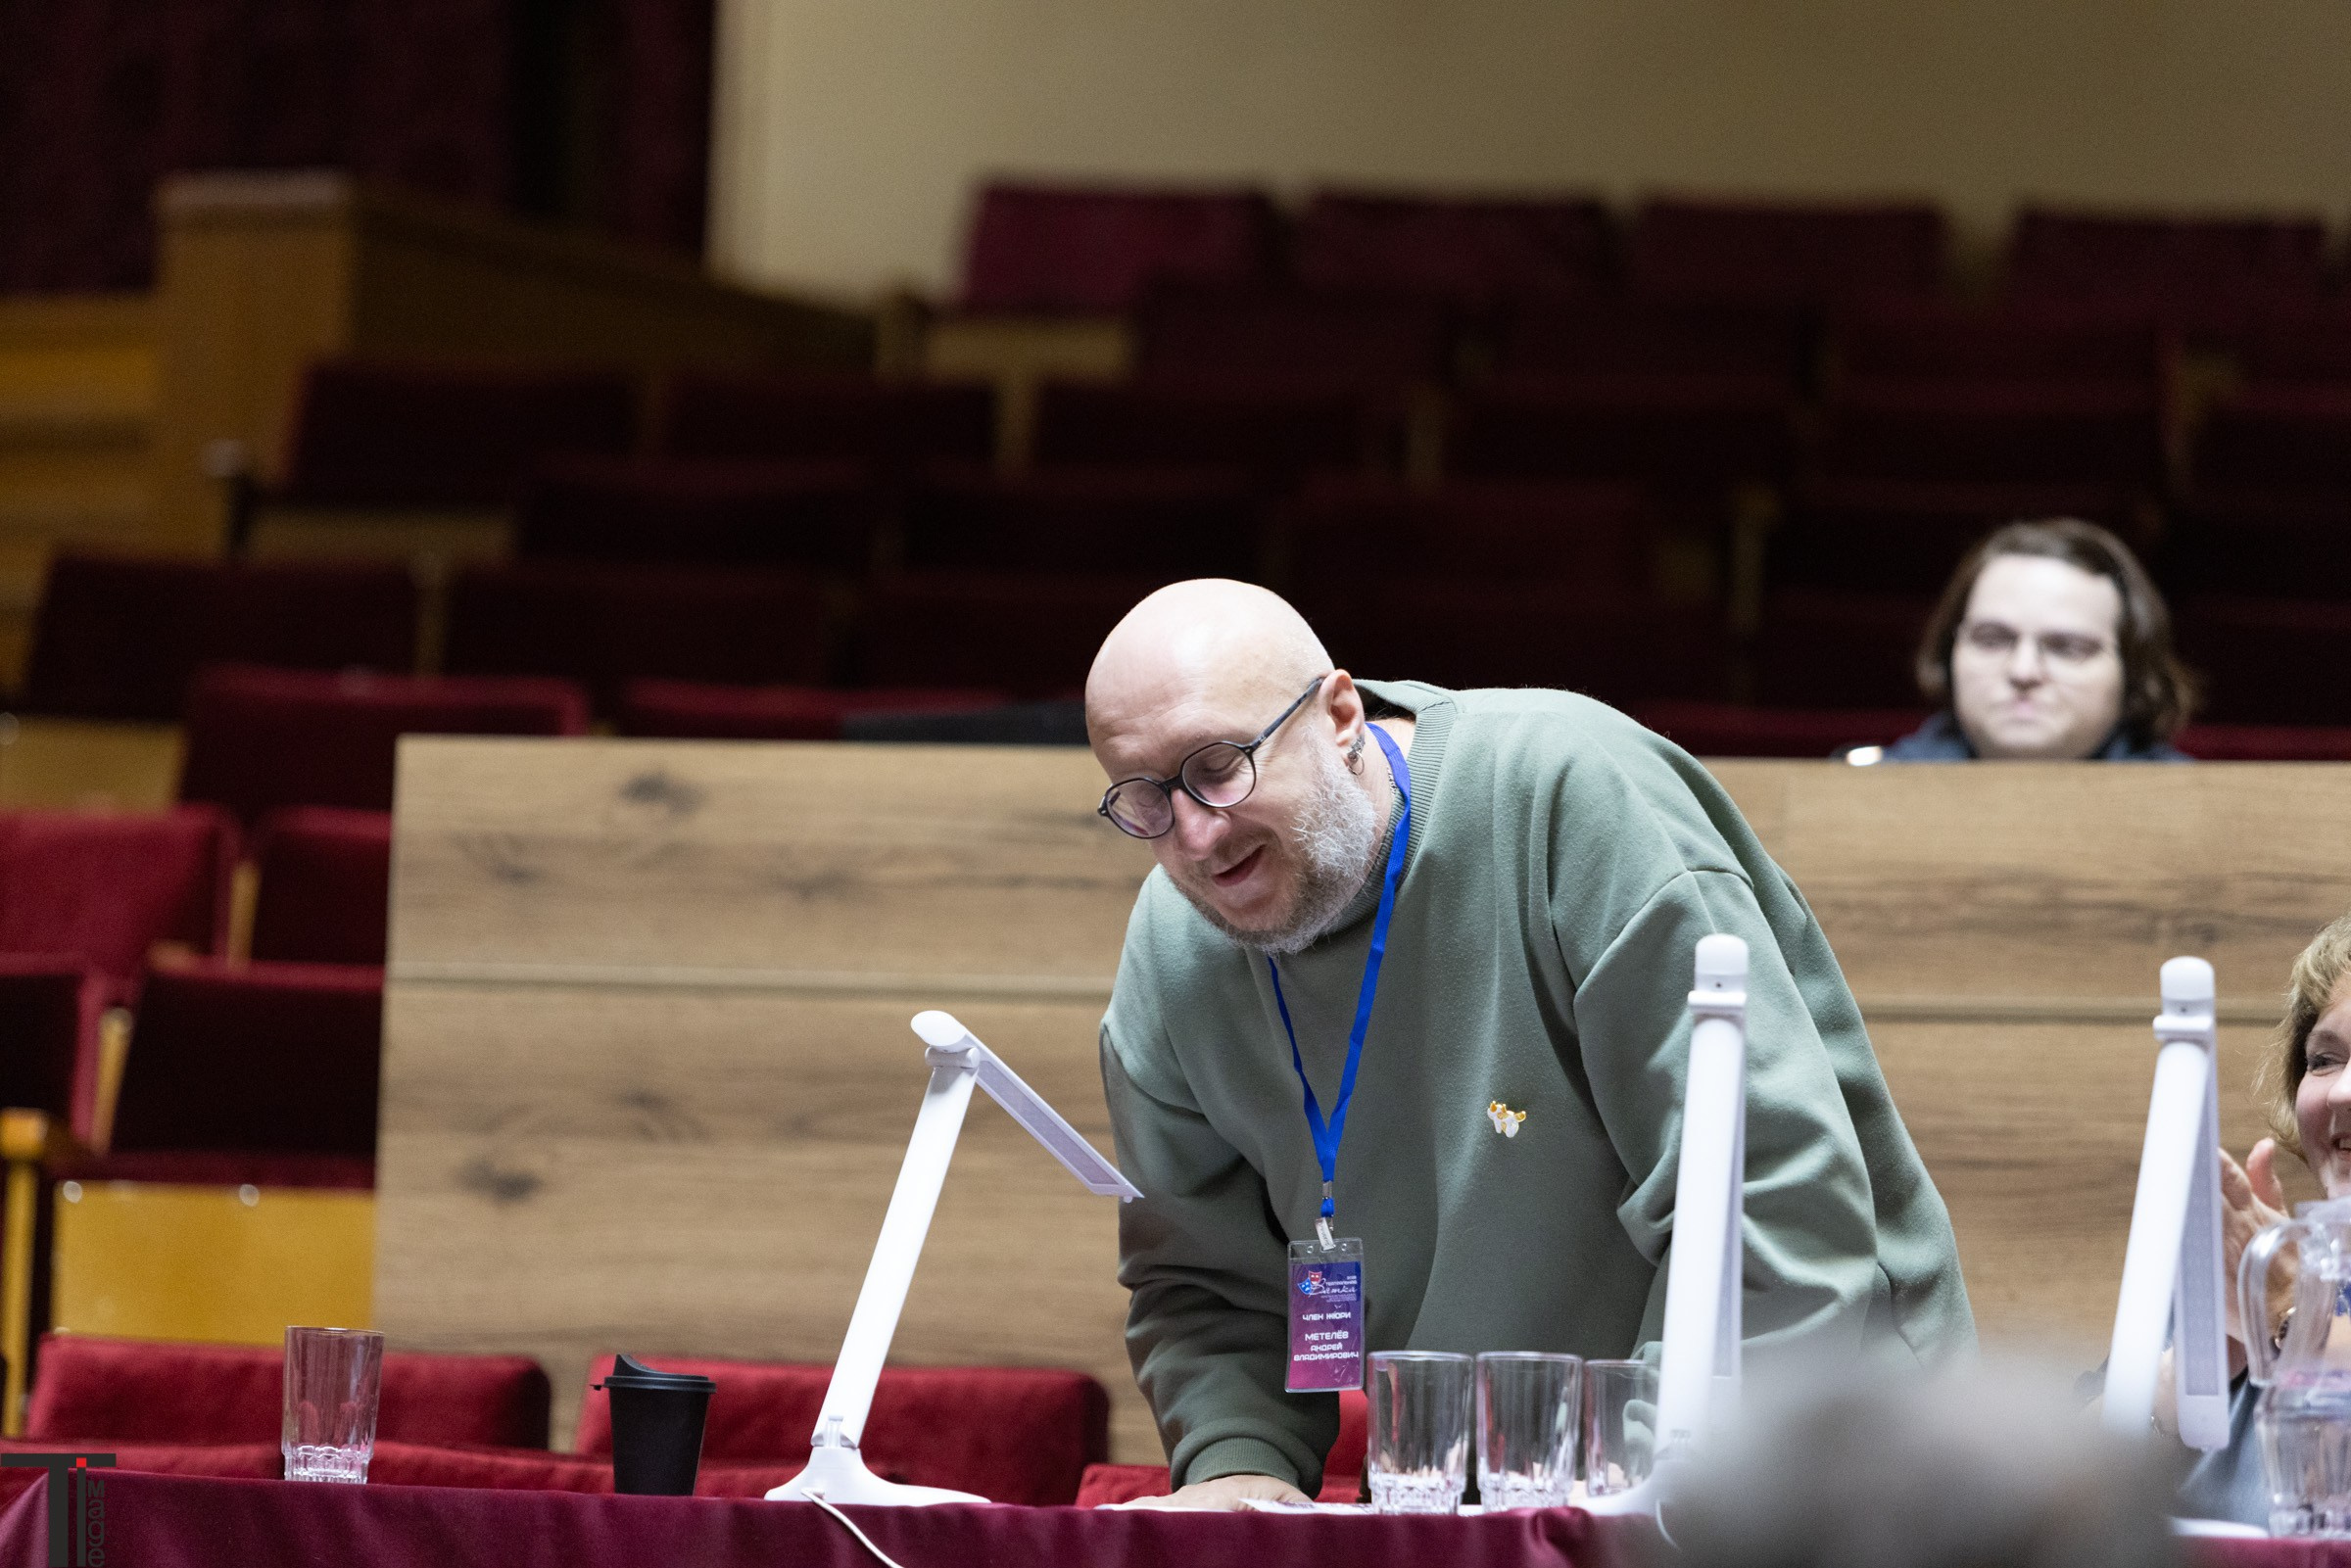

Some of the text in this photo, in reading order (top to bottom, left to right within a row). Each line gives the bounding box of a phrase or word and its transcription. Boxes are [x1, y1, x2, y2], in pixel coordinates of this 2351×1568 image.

[1326, 1311, 1351, 1320] ЖЮРИ
[1305, 1330, 1349, 1341] МЕТЕЛЁВ
[1311, 1342, 1343, 1352] АНДРЕЙ
[1293, 1352, 1359, 1361] ВЛАДИМИРОВИЧ
